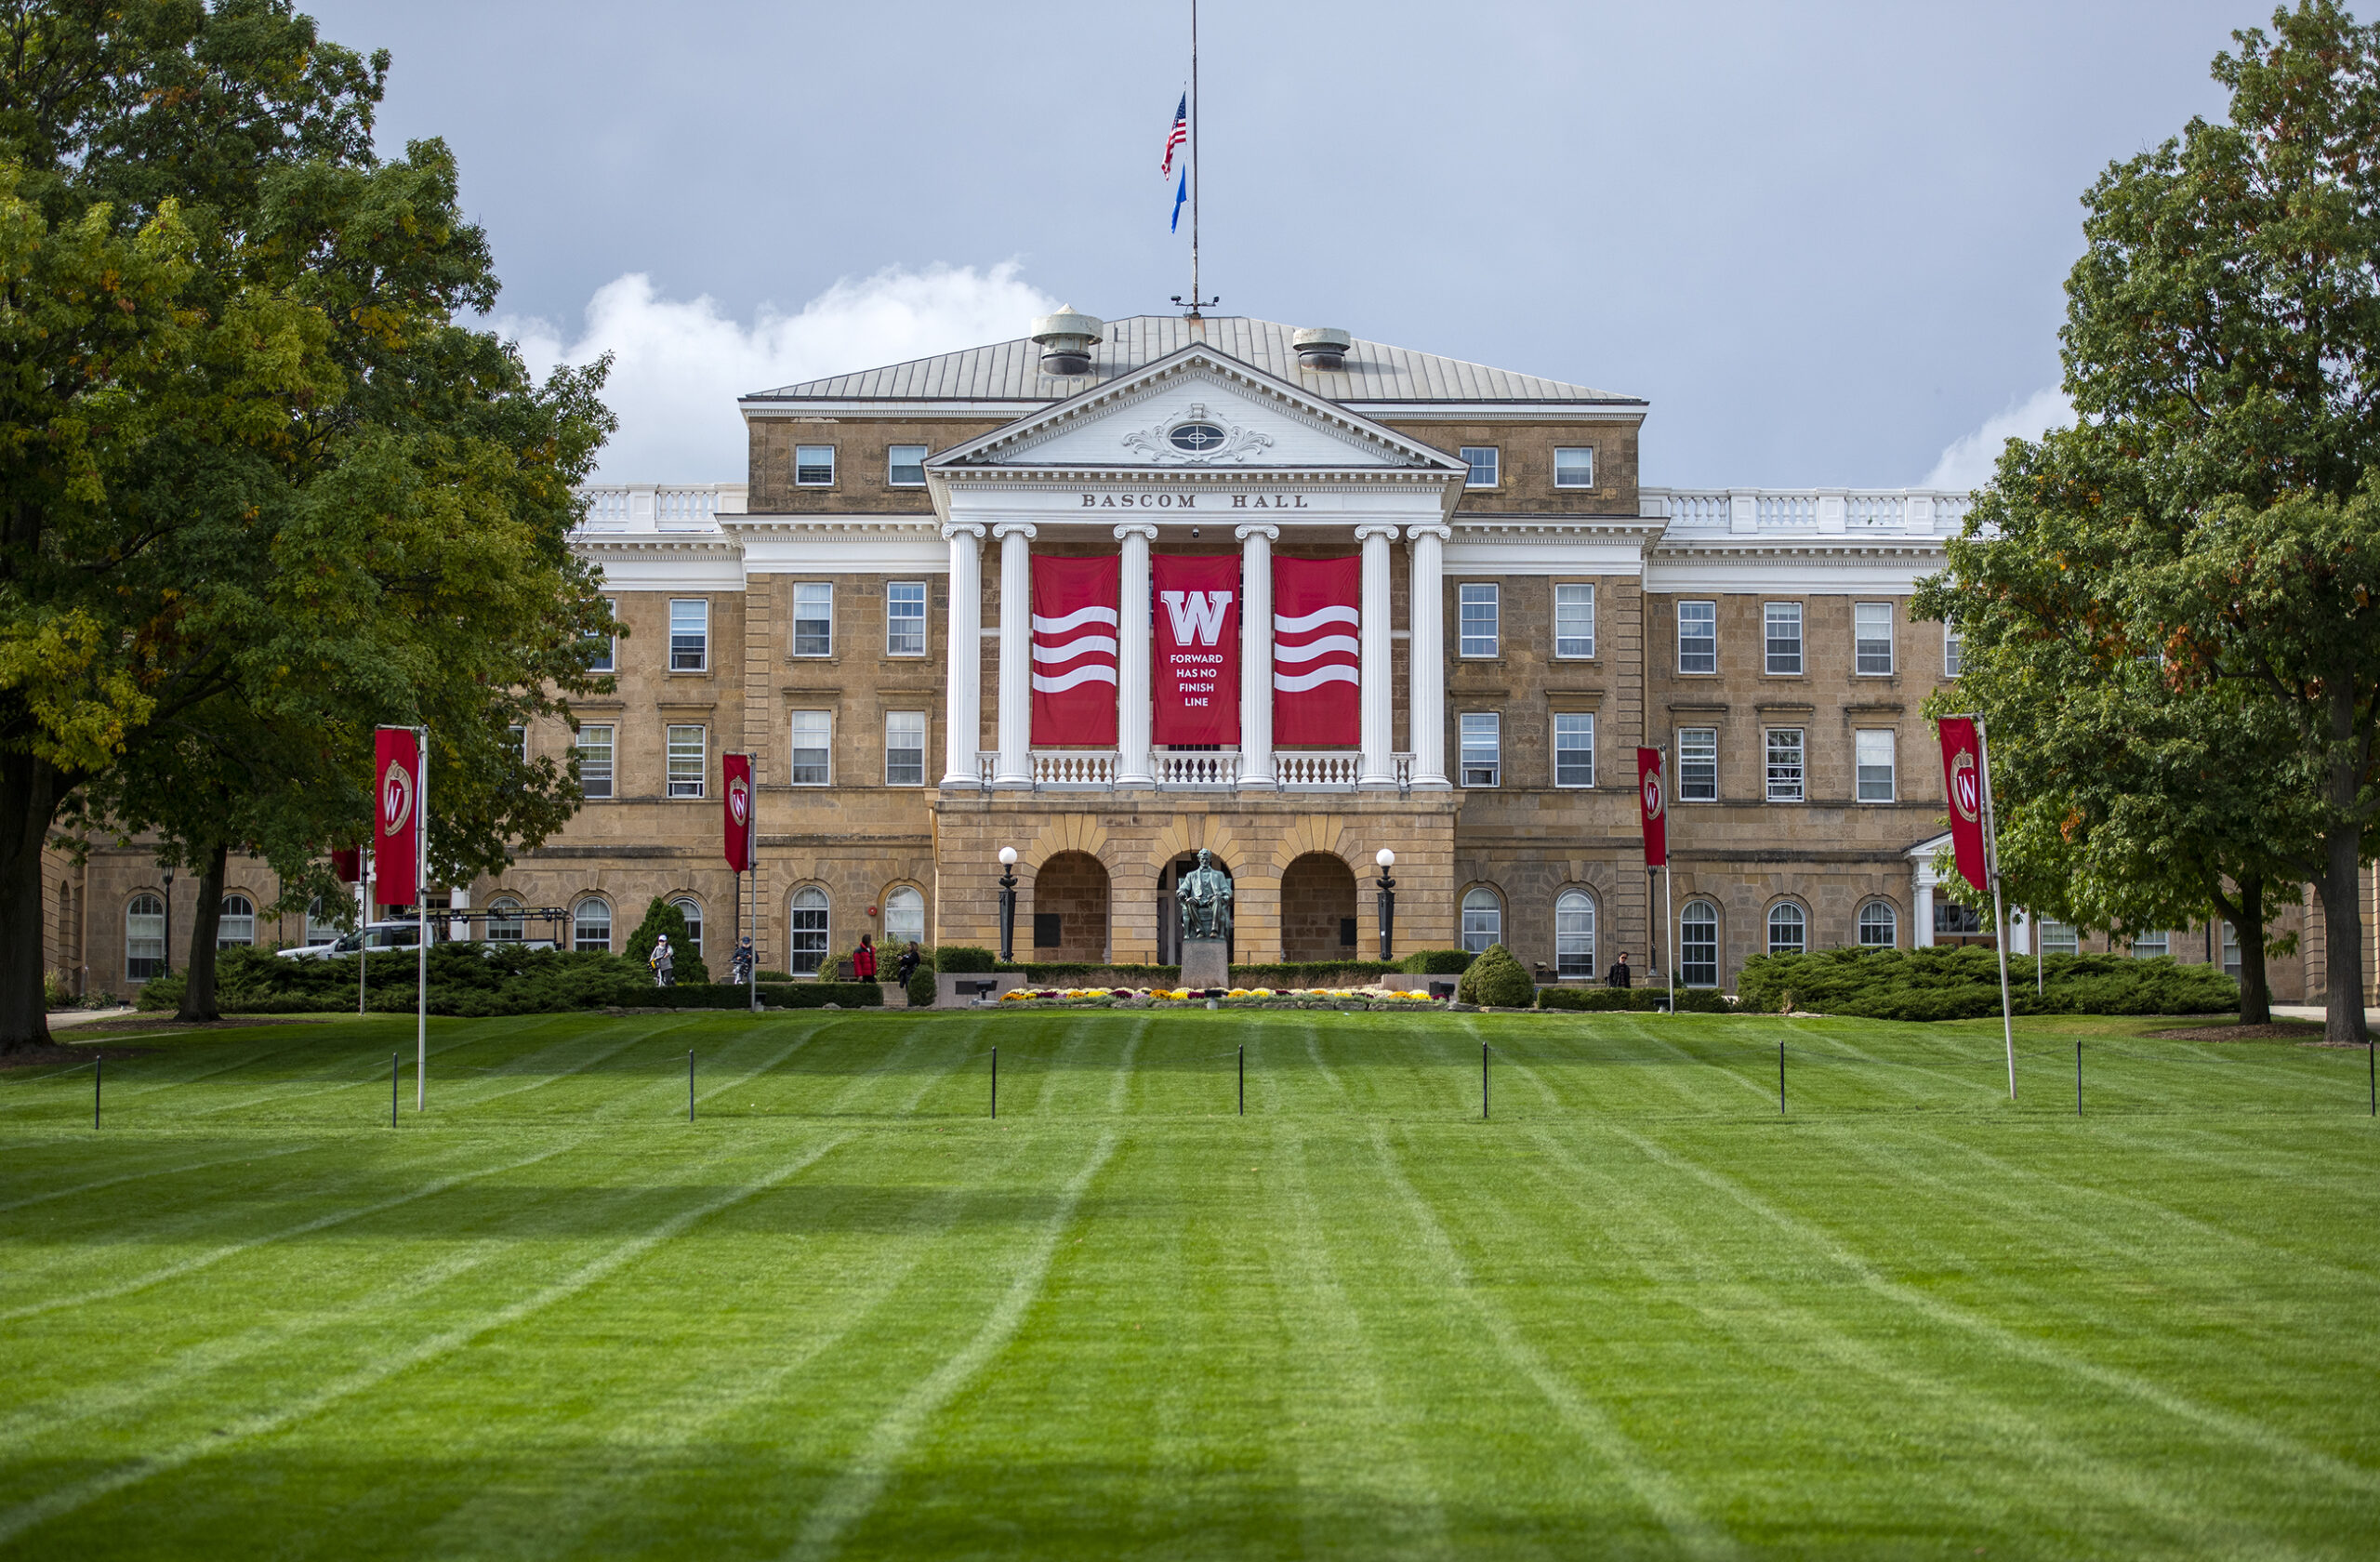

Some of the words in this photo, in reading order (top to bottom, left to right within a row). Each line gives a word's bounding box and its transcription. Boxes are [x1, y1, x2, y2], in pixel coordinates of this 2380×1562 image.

[1081, 494, 1196, 509] BASCOM
[1231, 494, 1308, 509] HALL
[1160, 590, 1233, 646] W
[1170, 654, 1223, 664] FORWARD
[1176, 668, 1198, 678] HAS
[1200, 668, 1217, 678] NO
[1179, 683, 1214, 693] FINISH
[1184, 697, 1209, 707] LINE
[1958, 773, 1976, 809] W
[386, 786, 402, 821] W
[733, 793, 745, 816] W
